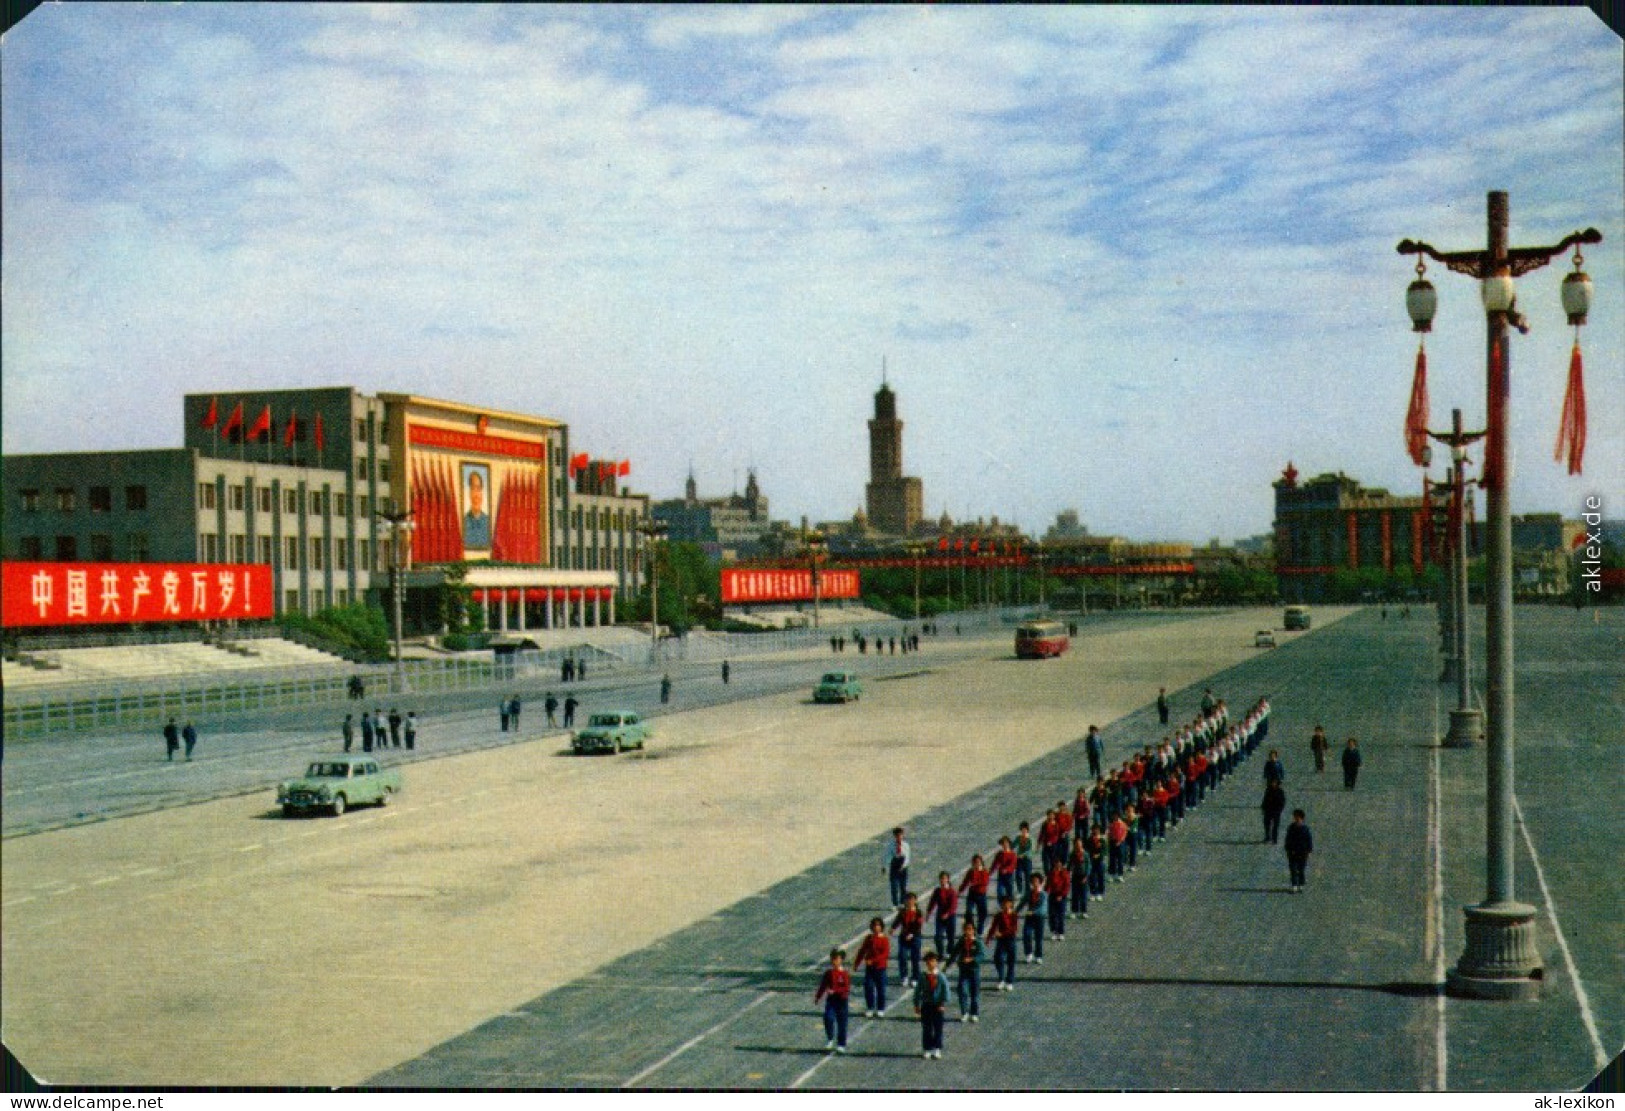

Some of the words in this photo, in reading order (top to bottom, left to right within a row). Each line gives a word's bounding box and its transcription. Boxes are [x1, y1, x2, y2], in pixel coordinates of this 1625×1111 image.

[31, 569, 252, 618] 中国共产党万岁!
